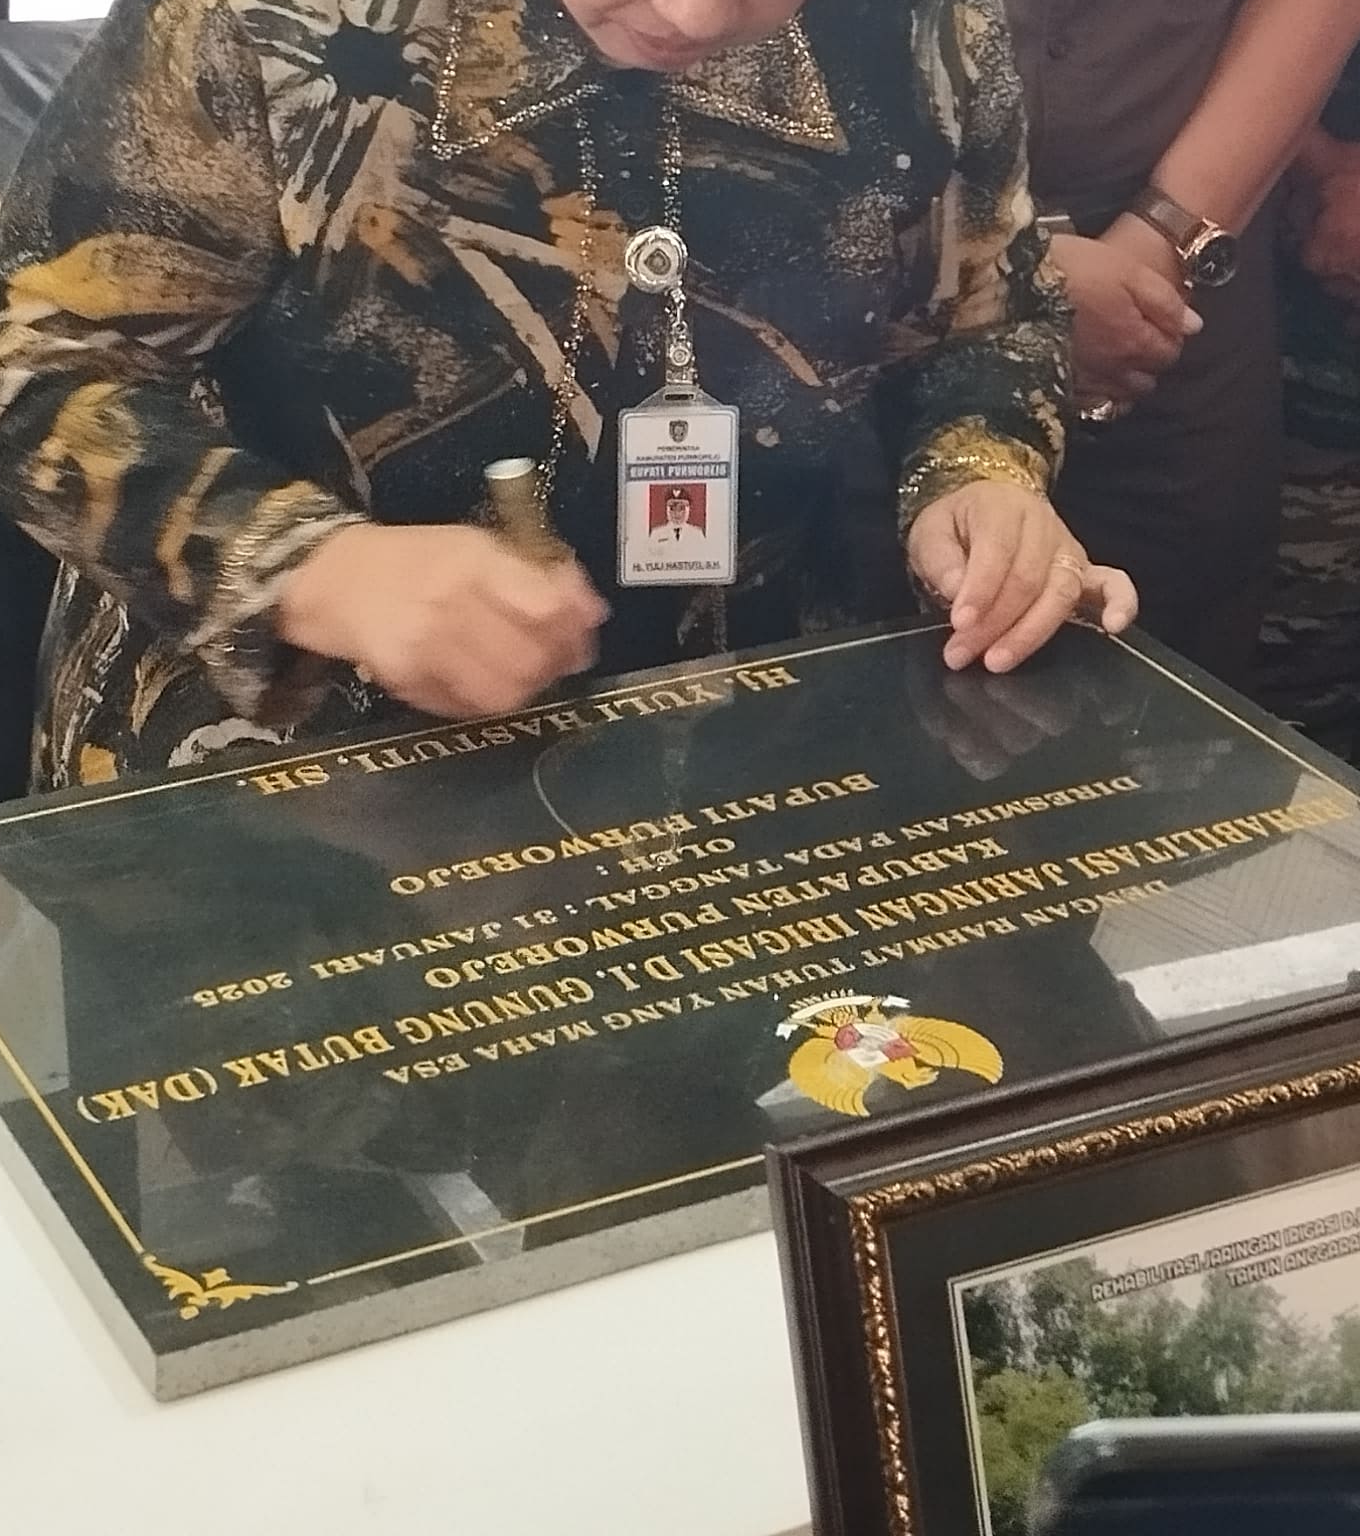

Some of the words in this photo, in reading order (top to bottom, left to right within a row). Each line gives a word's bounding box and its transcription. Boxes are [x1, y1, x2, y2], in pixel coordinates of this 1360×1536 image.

[593, 686, 720, 724] YULI
[725, 665, 801, 695] Hj.
[337, 710, 579, 775] HASTUTI,
[235, 763, 333, 796] SH.
[698, 772, 881, 825] BUPATI
[899, 775, 1143, 841] DIRESMIKAN
[389, 812, 699, 897] PURWOREJO
[617, 836, 737, 875] OLEH
[783, 831, 897, 866] PADA
[1066, 796, 1354, 880] REHABILITASI
[584, 858, 785, 912] TANGGAL
[730, 836, 1009, 915] KABUPATEN
[855, 861, 1070, 932] JARINGAN
[511, 910, 559, 931] 31
[1021, 879, 1171, 929] DENGAN
[308, 920, 504, 981] JANUARI
[422, 903, 731, 990] PURWOREJO
[678, 913, 860, 974] IRIGASI
[859, 916, 1019, 968] RAHMAT
[191, 970, 295, 1010] 2025
[717, 957, 857, 1003] TUHAN
[395, 976, 595, 1045] GUNUNG
[601, 991, 716, 1033] YANG
[222, 1024, 397, 1089] BUTAK
[474, 1019, 599, 1063] MAHA
[382, 1051, 472, 1085] ESA
[75, 1066, 220, 1125] (DAK)
[1090, 1254, 1201, 1304] REHABILITASI
[1202, 1230, 1282, 1269] JARINGAN
[1283, 1213, 1341, 1247] IRIGASI
[1226, 1258, 1284, 1288] TAHUN
